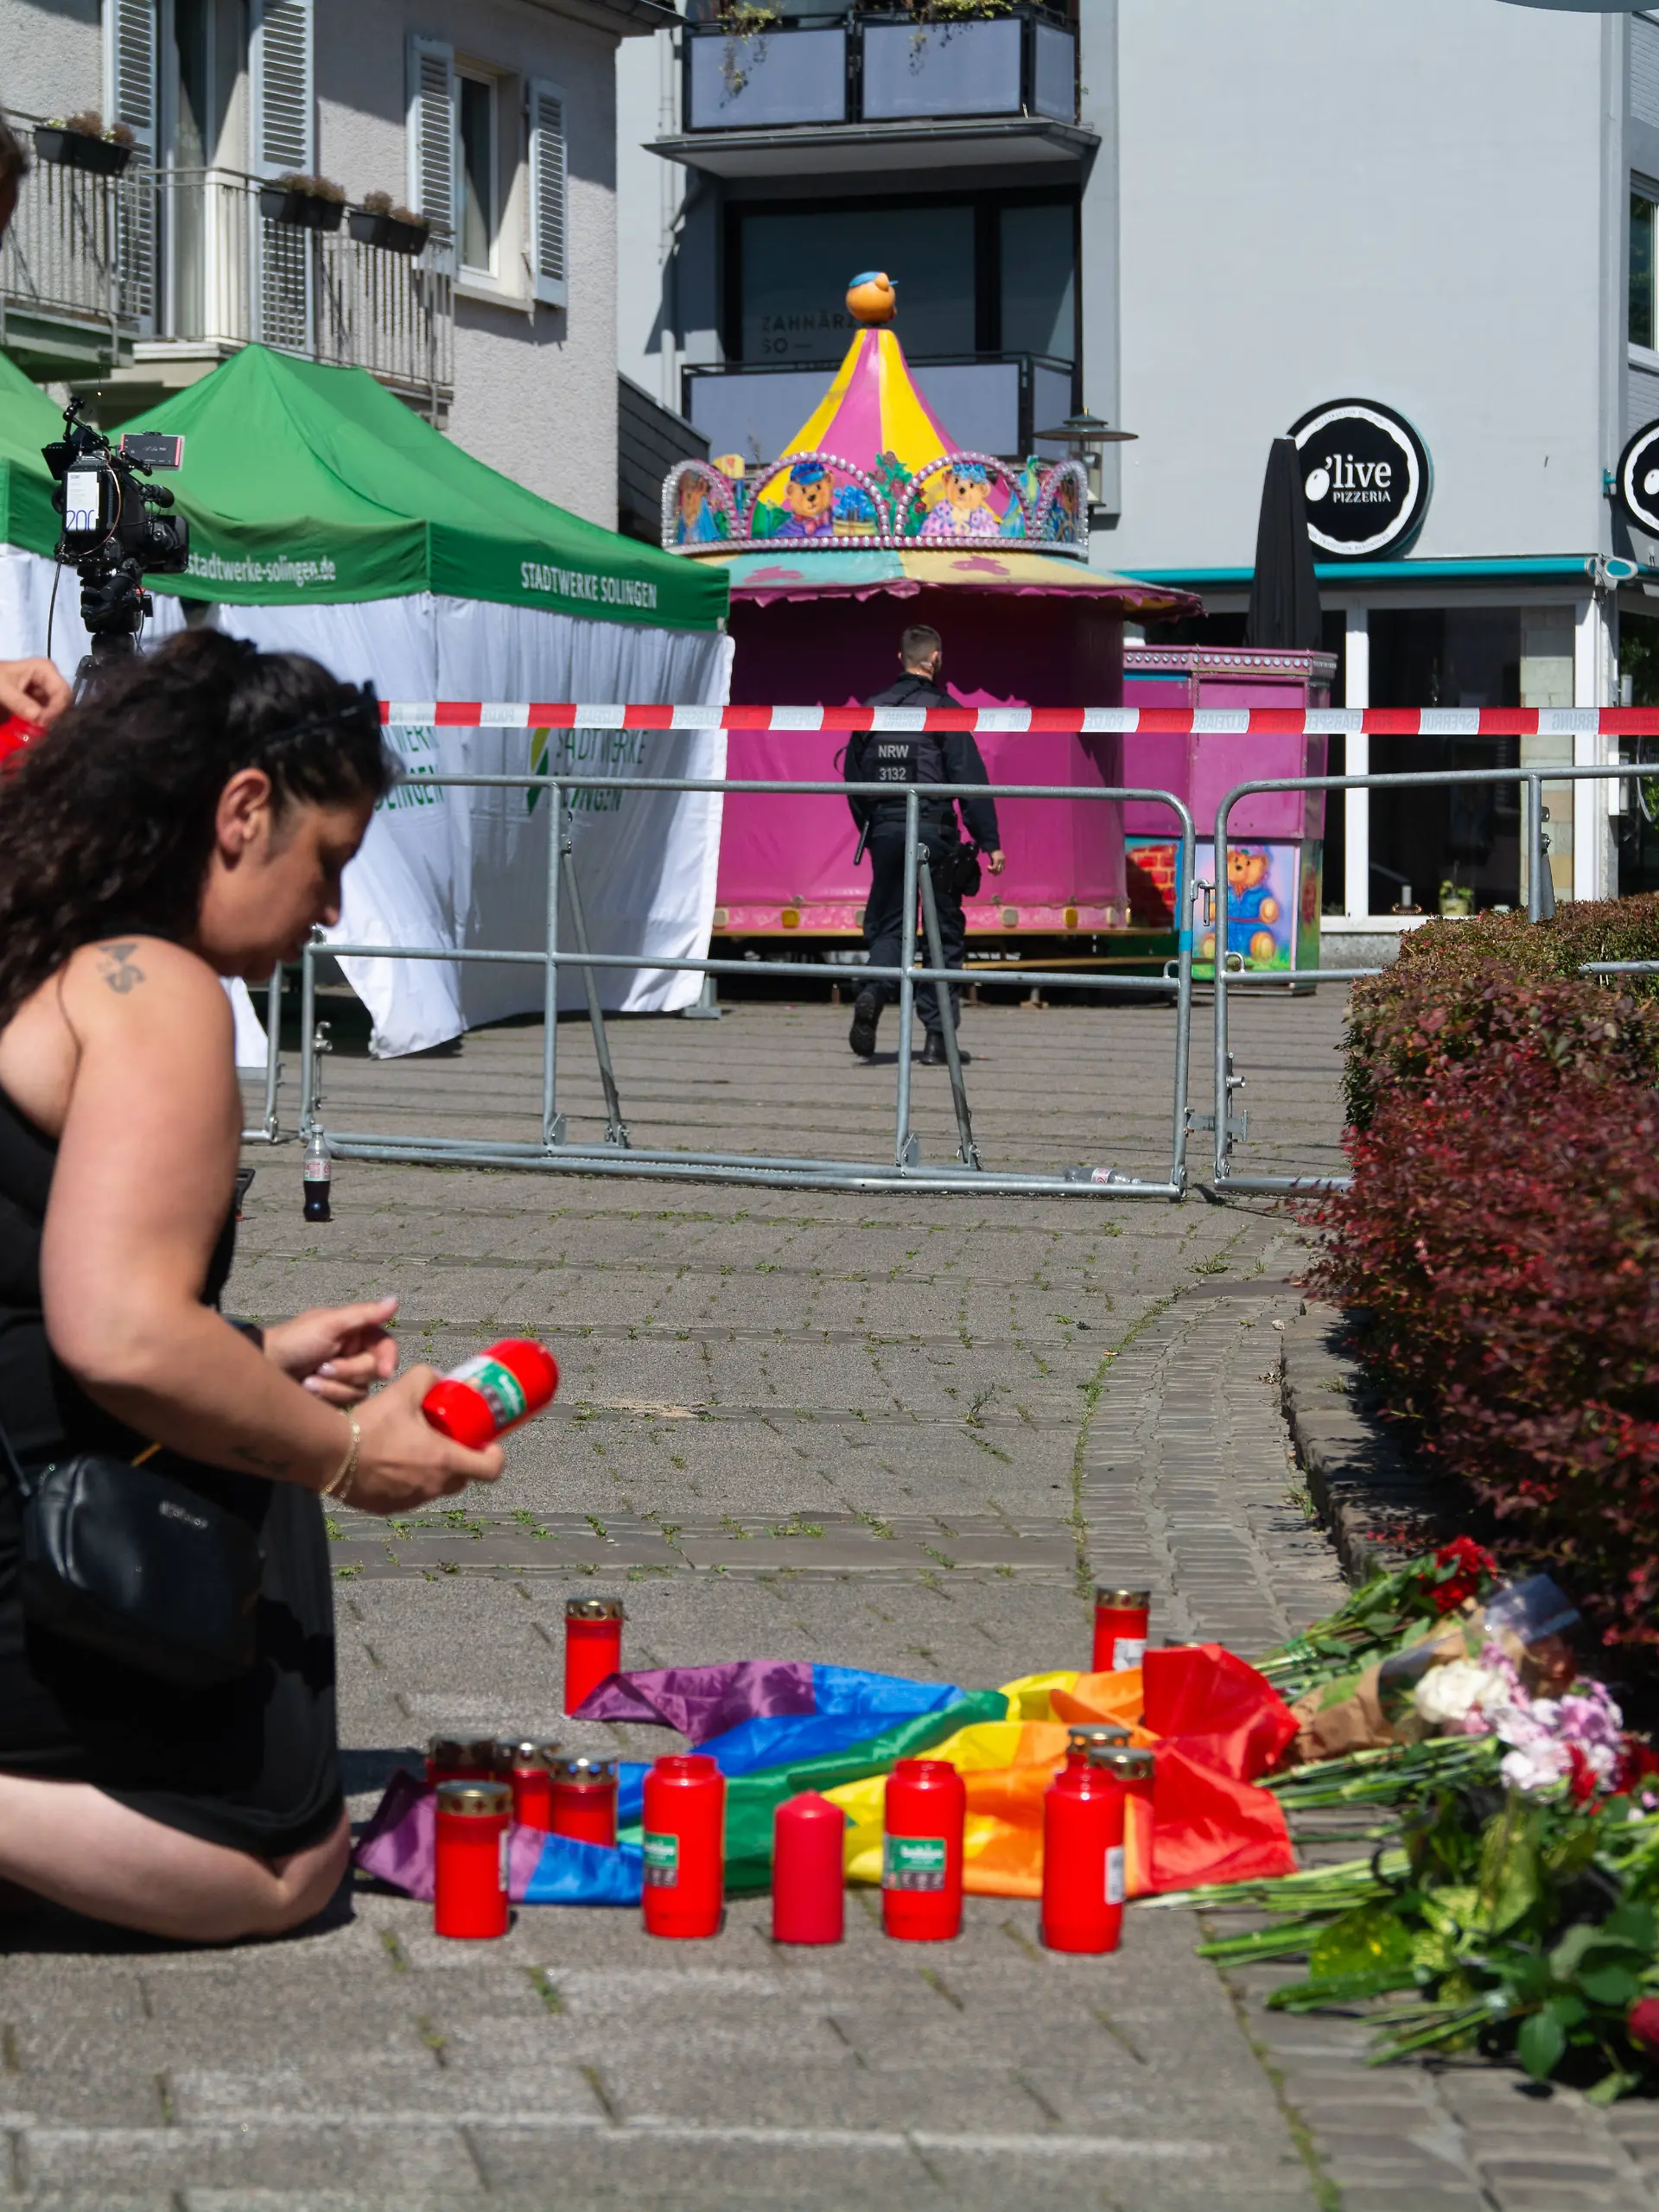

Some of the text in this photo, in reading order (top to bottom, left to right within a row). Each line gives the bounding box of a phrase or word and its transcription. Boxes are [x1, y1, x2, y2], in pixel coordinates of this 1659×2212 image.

[760, 308, 857, 332] ZAHNÄRZ
[762, 338, 787, 354] SO
[1332, 490, 1392, 504] PIZZERIA
[521, 562, 657, 608] STADTWERKE SOLINGEN
[878, 745, 909, 758] NRW
[879, 767, 906, 781] 3132
